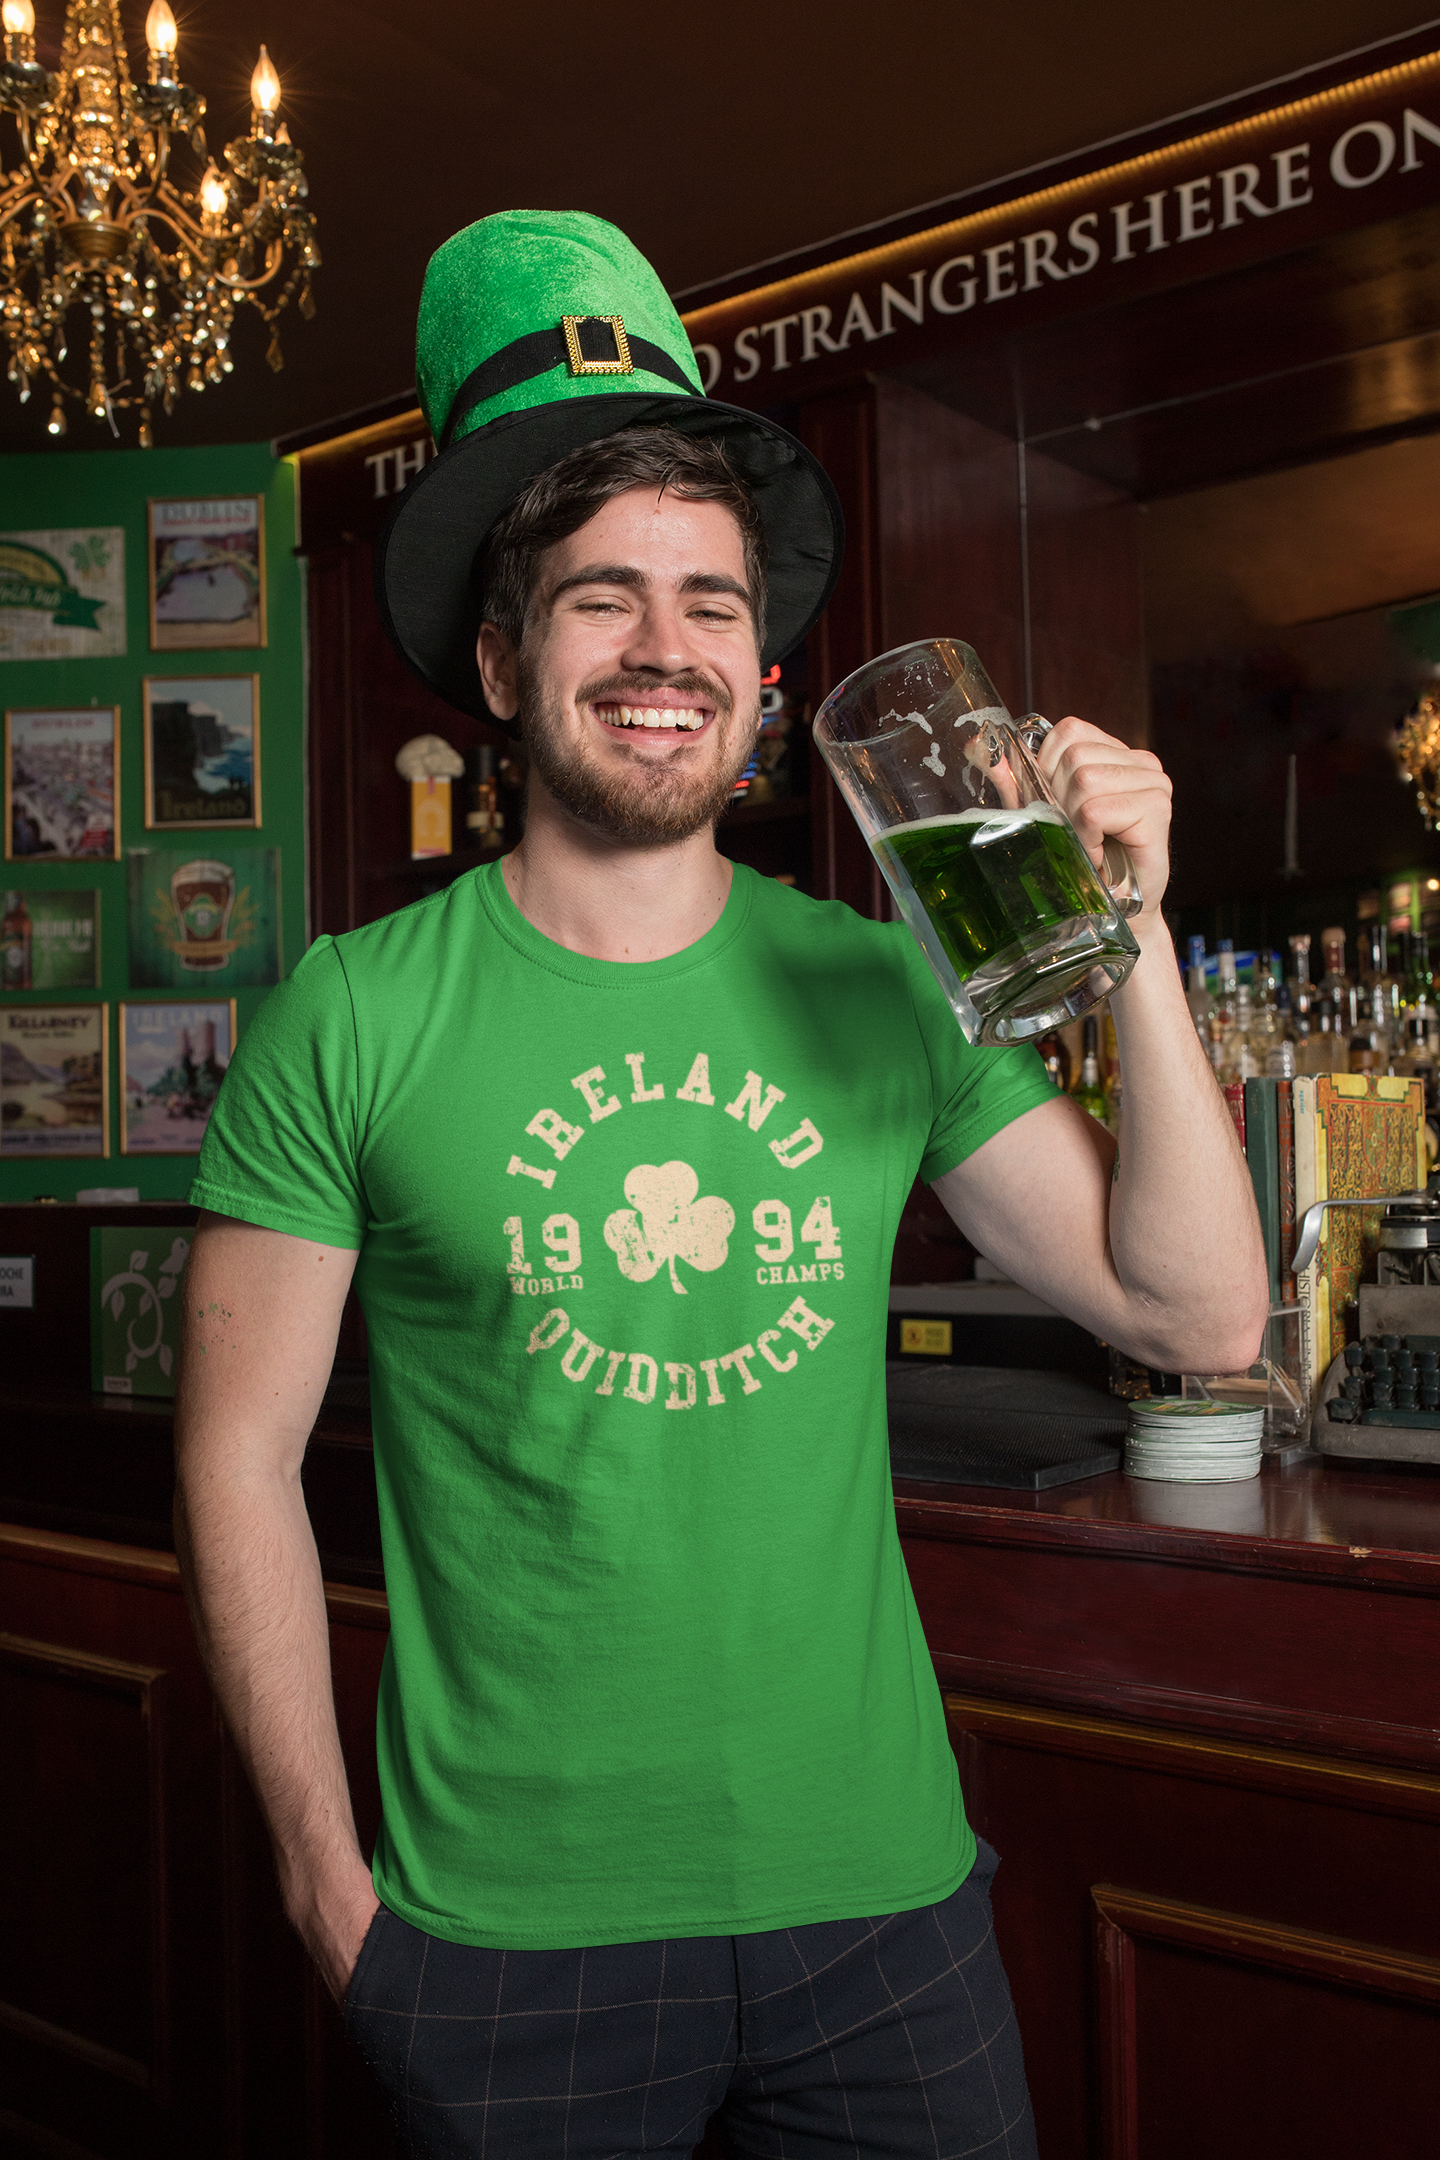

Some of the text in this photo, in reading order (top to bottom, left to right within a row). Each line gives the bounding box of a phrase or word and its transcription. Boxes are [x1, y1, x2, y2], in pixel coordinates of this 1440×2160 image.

[364, 436, 438, 499] TH
[733, 212, 1101, 383] STRANGERS
[1110, 142, 1314, 264] HERE
[506, 1051, 824, 1189] IRELAND
[503, 1195, 842, 1276] 19 94
[509, 1262, 846, 1297] WORLD CHAMPS
[1281, 1232, 1293, 1282] Historia
[526, 1295, 836, 1410] QUIDDITCH
